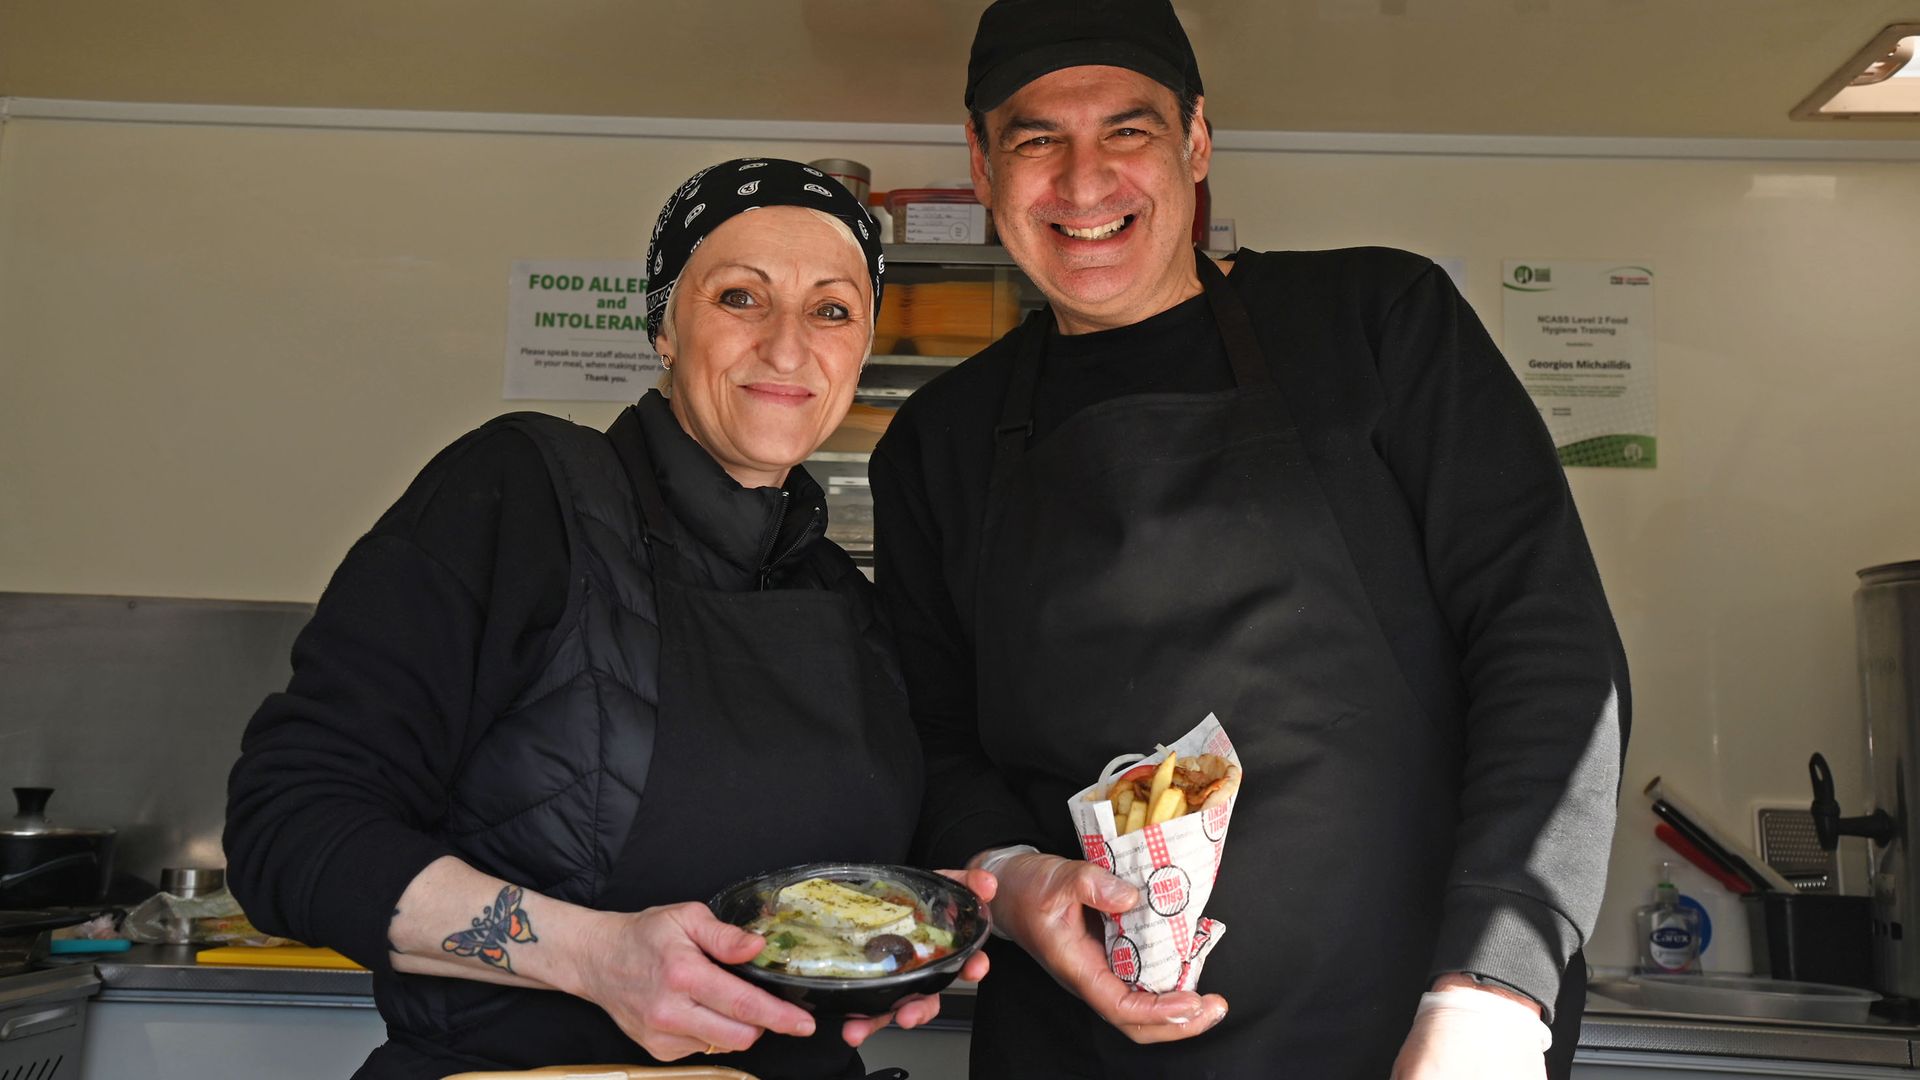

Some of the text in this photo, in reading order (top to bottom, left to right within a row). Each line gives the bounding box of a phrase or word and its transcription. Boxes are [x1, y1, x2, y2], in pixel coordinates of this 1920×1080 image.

[528, 274, 584, 291] FOOD
[596, 297, 627, 309] and
[534, 312, 648, 331] INTOLERAN
[1537, 315, 1629, 325] NCASS Level 2 Food
[1541, 326, 1616, 336] Hygiene Training
[520, 347, 546, 356] Please
[547, 348, 569, 358] speak
[571, 349, 579, 357] to
[595, 350, 613, 358] staff
[614, 351, 637, 360] about
[638, 352, 651, 360] the
[534, 359, 542, 367] in
[543, 361, 561, 370] your
[585, 361, 607, 369] when
[608, 362, 636, 372] making
[638, 364, 656, 372] your
[1528, 359, 1631, 371] Georgios Michailidis
[584, 373, 628, 384] Thank you.
[1153, 876, 1181, 894] MENU
[1155, 888, 1183, 909] GRILL
